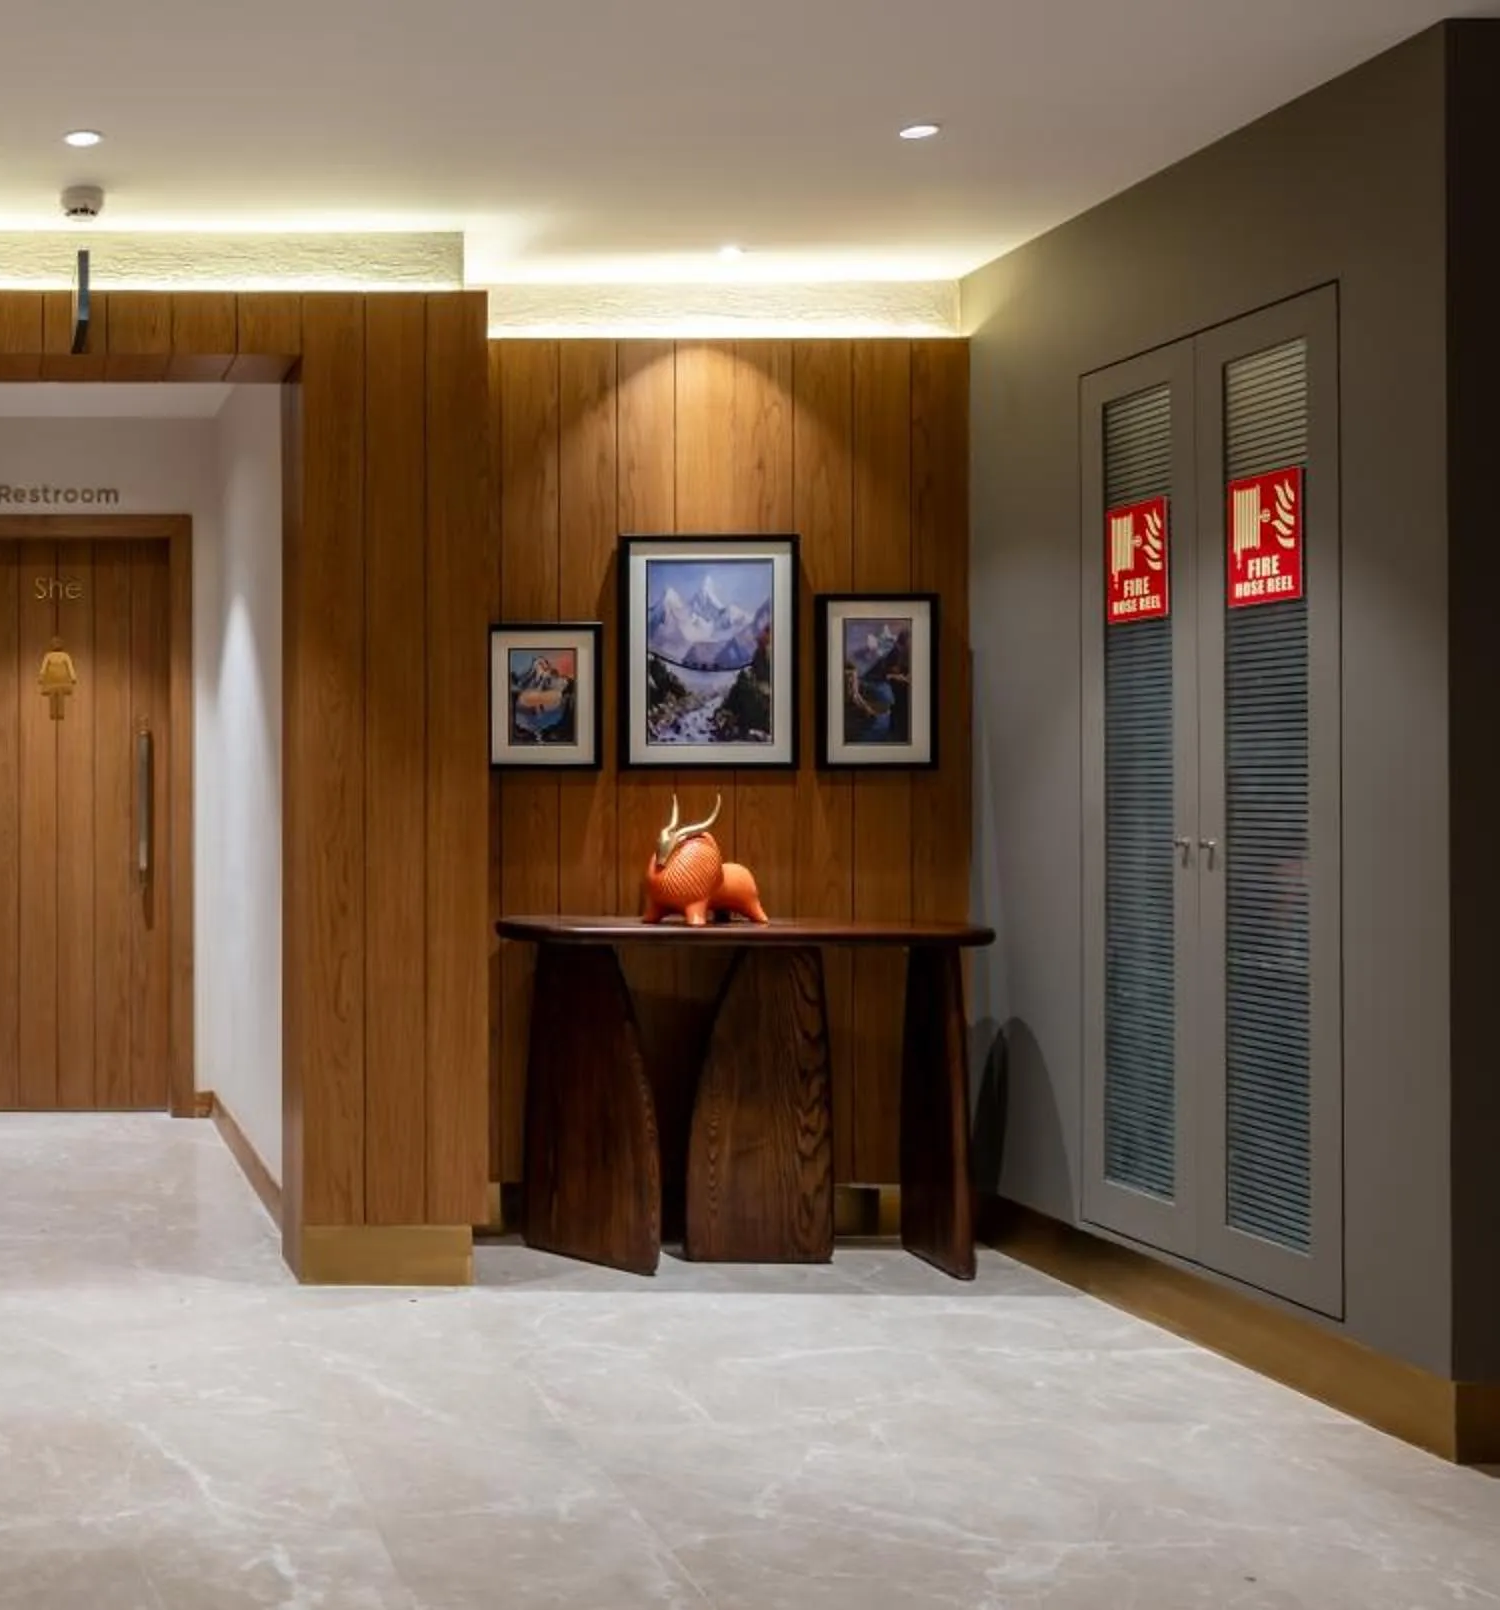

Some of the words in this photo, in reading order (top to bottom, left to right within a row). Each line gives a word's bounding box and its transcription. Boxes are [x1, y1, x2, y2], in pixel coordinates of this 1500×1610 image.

[1247, 555, 1279, 578] FIRE
[34, 577, 82, 599] She
[1123, 576, 1149, 597] FIRE
[1235, 579, 1264, 598] HOSE
[1267, 575, 1293, 593] REEL
[1113, 598, 1136, 615] HOSE
[1139, 595, 1160, 610] REEL
